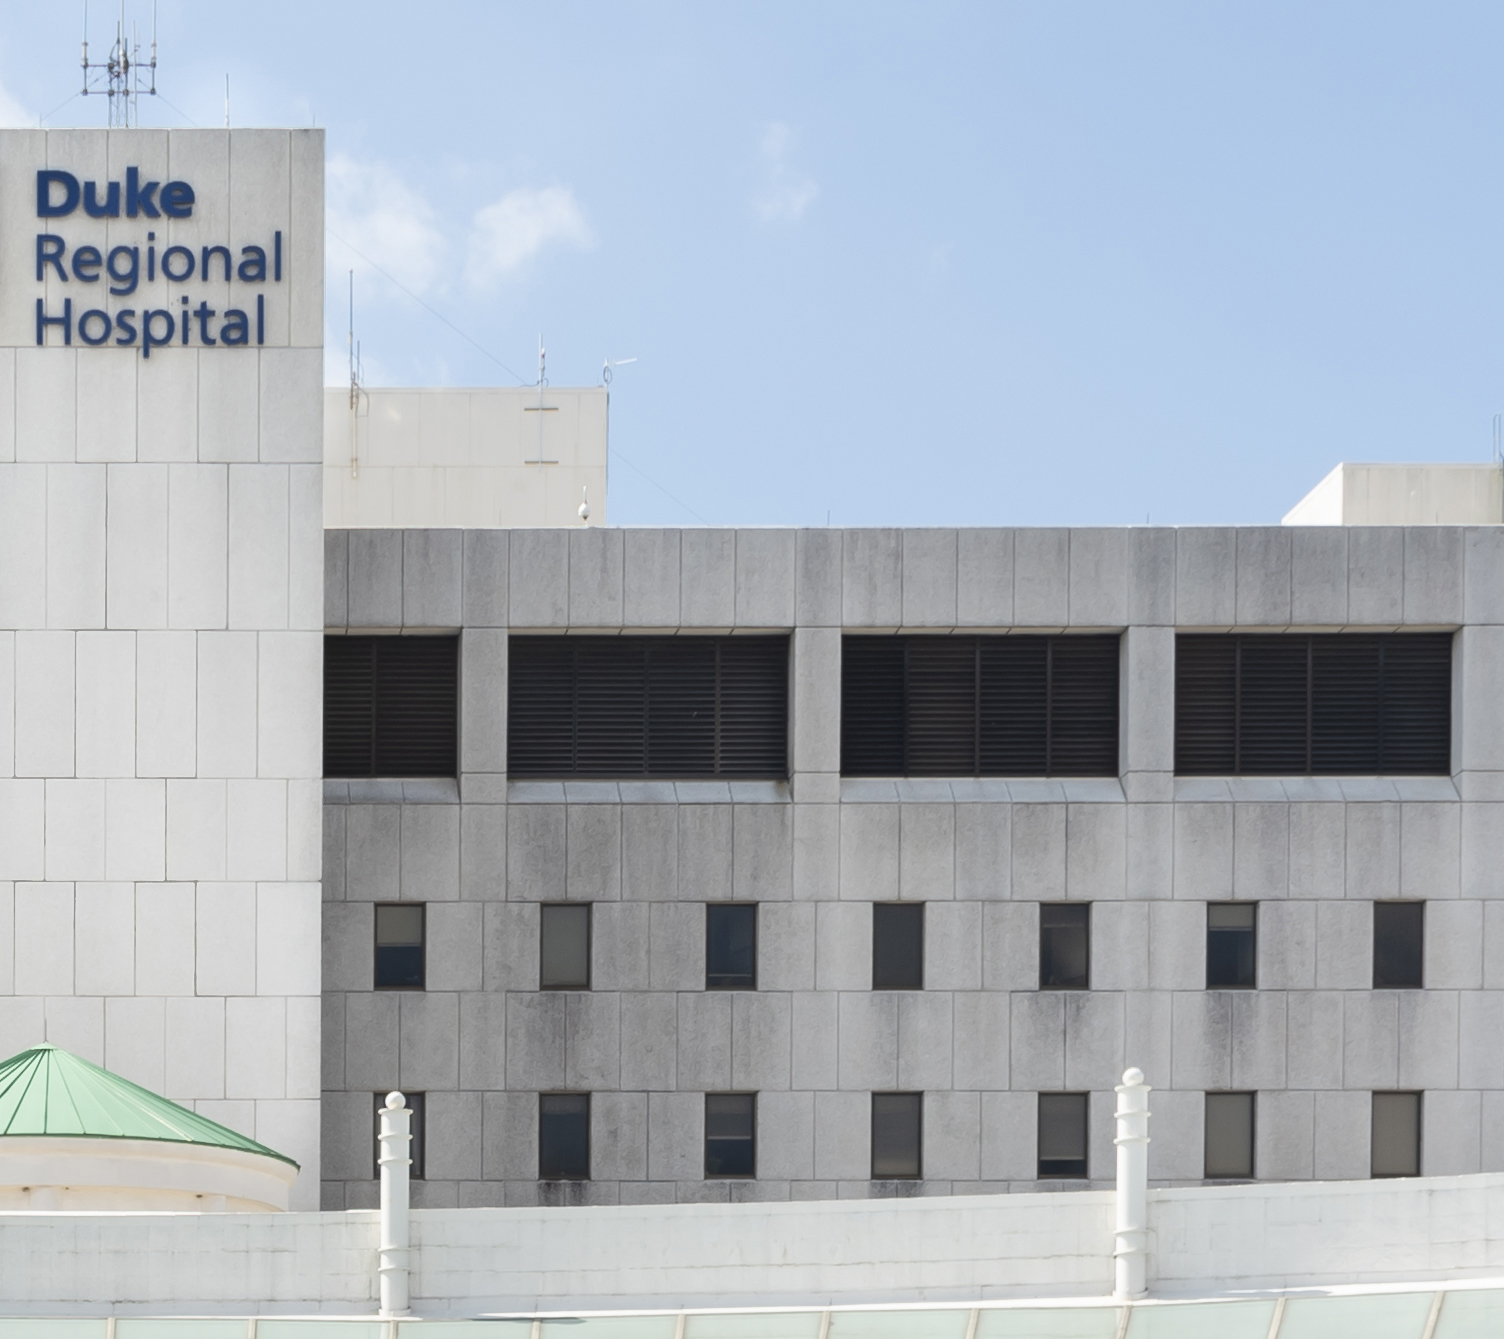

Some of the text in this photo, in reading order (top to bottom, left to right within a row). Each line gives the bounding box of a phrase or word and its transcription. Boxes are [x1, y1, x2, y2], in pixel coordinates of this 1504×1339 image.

[37, 167, 195, 219] Duke
[36, 231, 282, 295] Regional
[36, 295, 265, 358] Hospital
